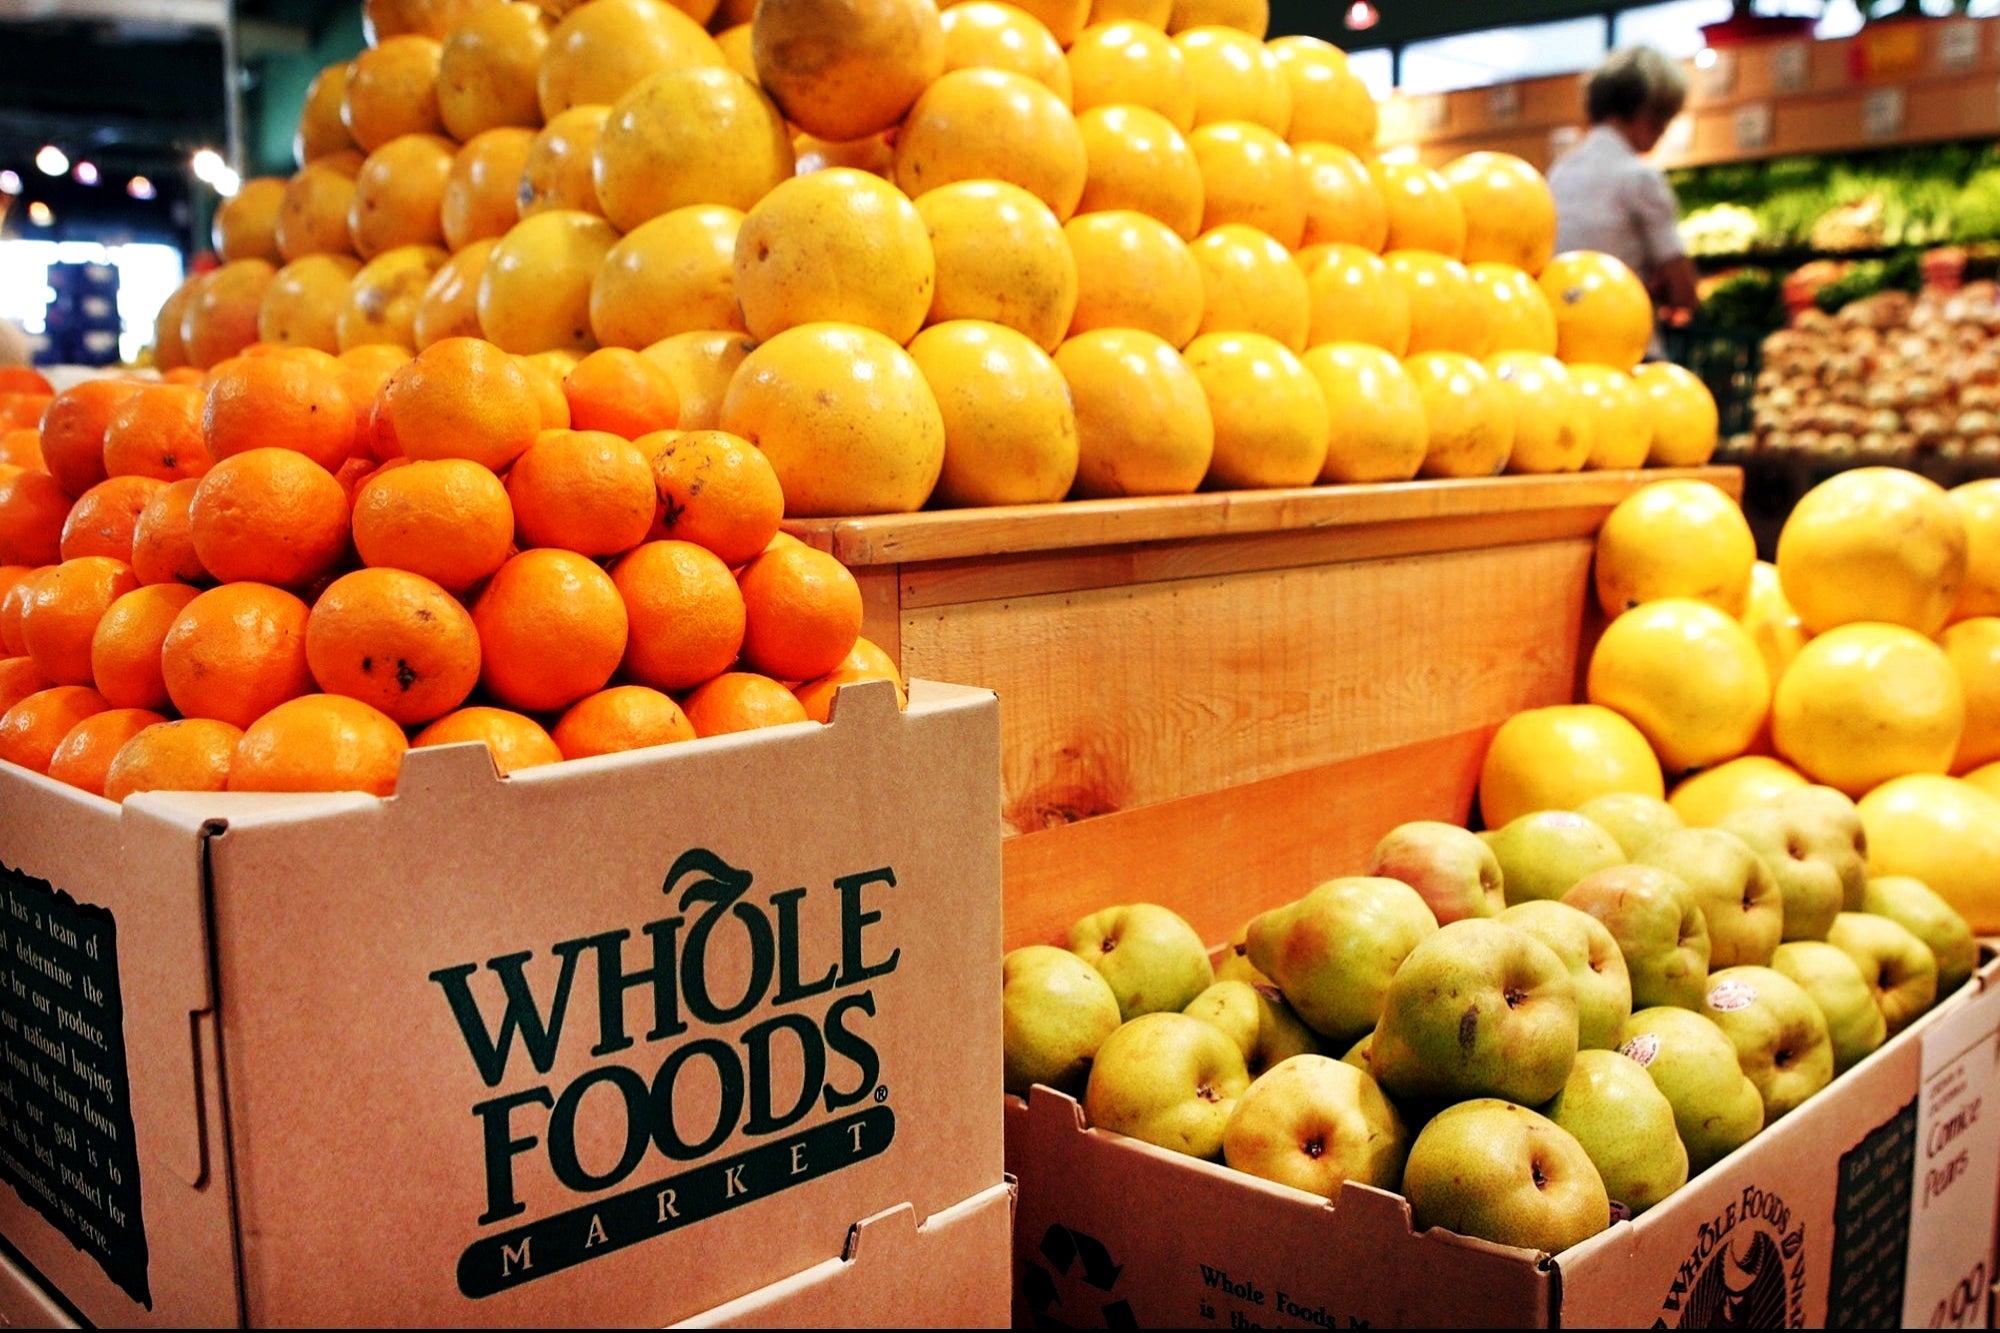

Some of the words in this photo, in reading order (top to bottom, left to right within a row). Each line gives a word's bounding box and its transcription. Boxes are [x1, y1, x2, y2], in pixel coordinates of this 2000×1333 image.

[9, 890, 28, 922] has
[35, 912, 42, 930] a
[48, 914, 78, 950] team
[85, 934, 99, 961] of
[429, 848, 900, 1087] WHOLE
[11, 970, 26, 999] for
[32, 990, 51, 1015] our
[57, 1006, 108, 1052] produce.
[16, 936, 73, 990] determine
[82, 975, 104, 1008] the
[1, 1009, 17, 1032] our
[23, 1024, 67, 1067] national
[71, 1048, 114, 1105] buying
[5, 1040, 30, 1078] from
[31, 1062, 49, 1094] the
[53, 1074, 80, 1114] farm
[84, 1098, 117, 1141] down
[26, 1100, 44, 1126] our
[53, 1122, 77, 1152] goal
[87, 1139, 98, 1168] is
[108, 1157, 122, 1185] to
[472, 990, 880, 1226] FOODS
[13, 1119, 29, 1149] the
[33, 1133, 55, 1171] best
[60, 1163, 103, 1211] product
[108, 1194, 126, 1228] for
[501, 1121, 867, 1277] MARKET
[60, 1200, 76, 1224] we
[78, 1215, 111, 1256] serve.
[1662, 1201, 1737, 1311] WHOLE
[1739, 1184, 1791, 1236] FOODS
[1200, 1263, 1264, 1305] Whole
[1276, 1291, 1337, 1329] Foods
[1200, 1297, 1216, 1320] is
